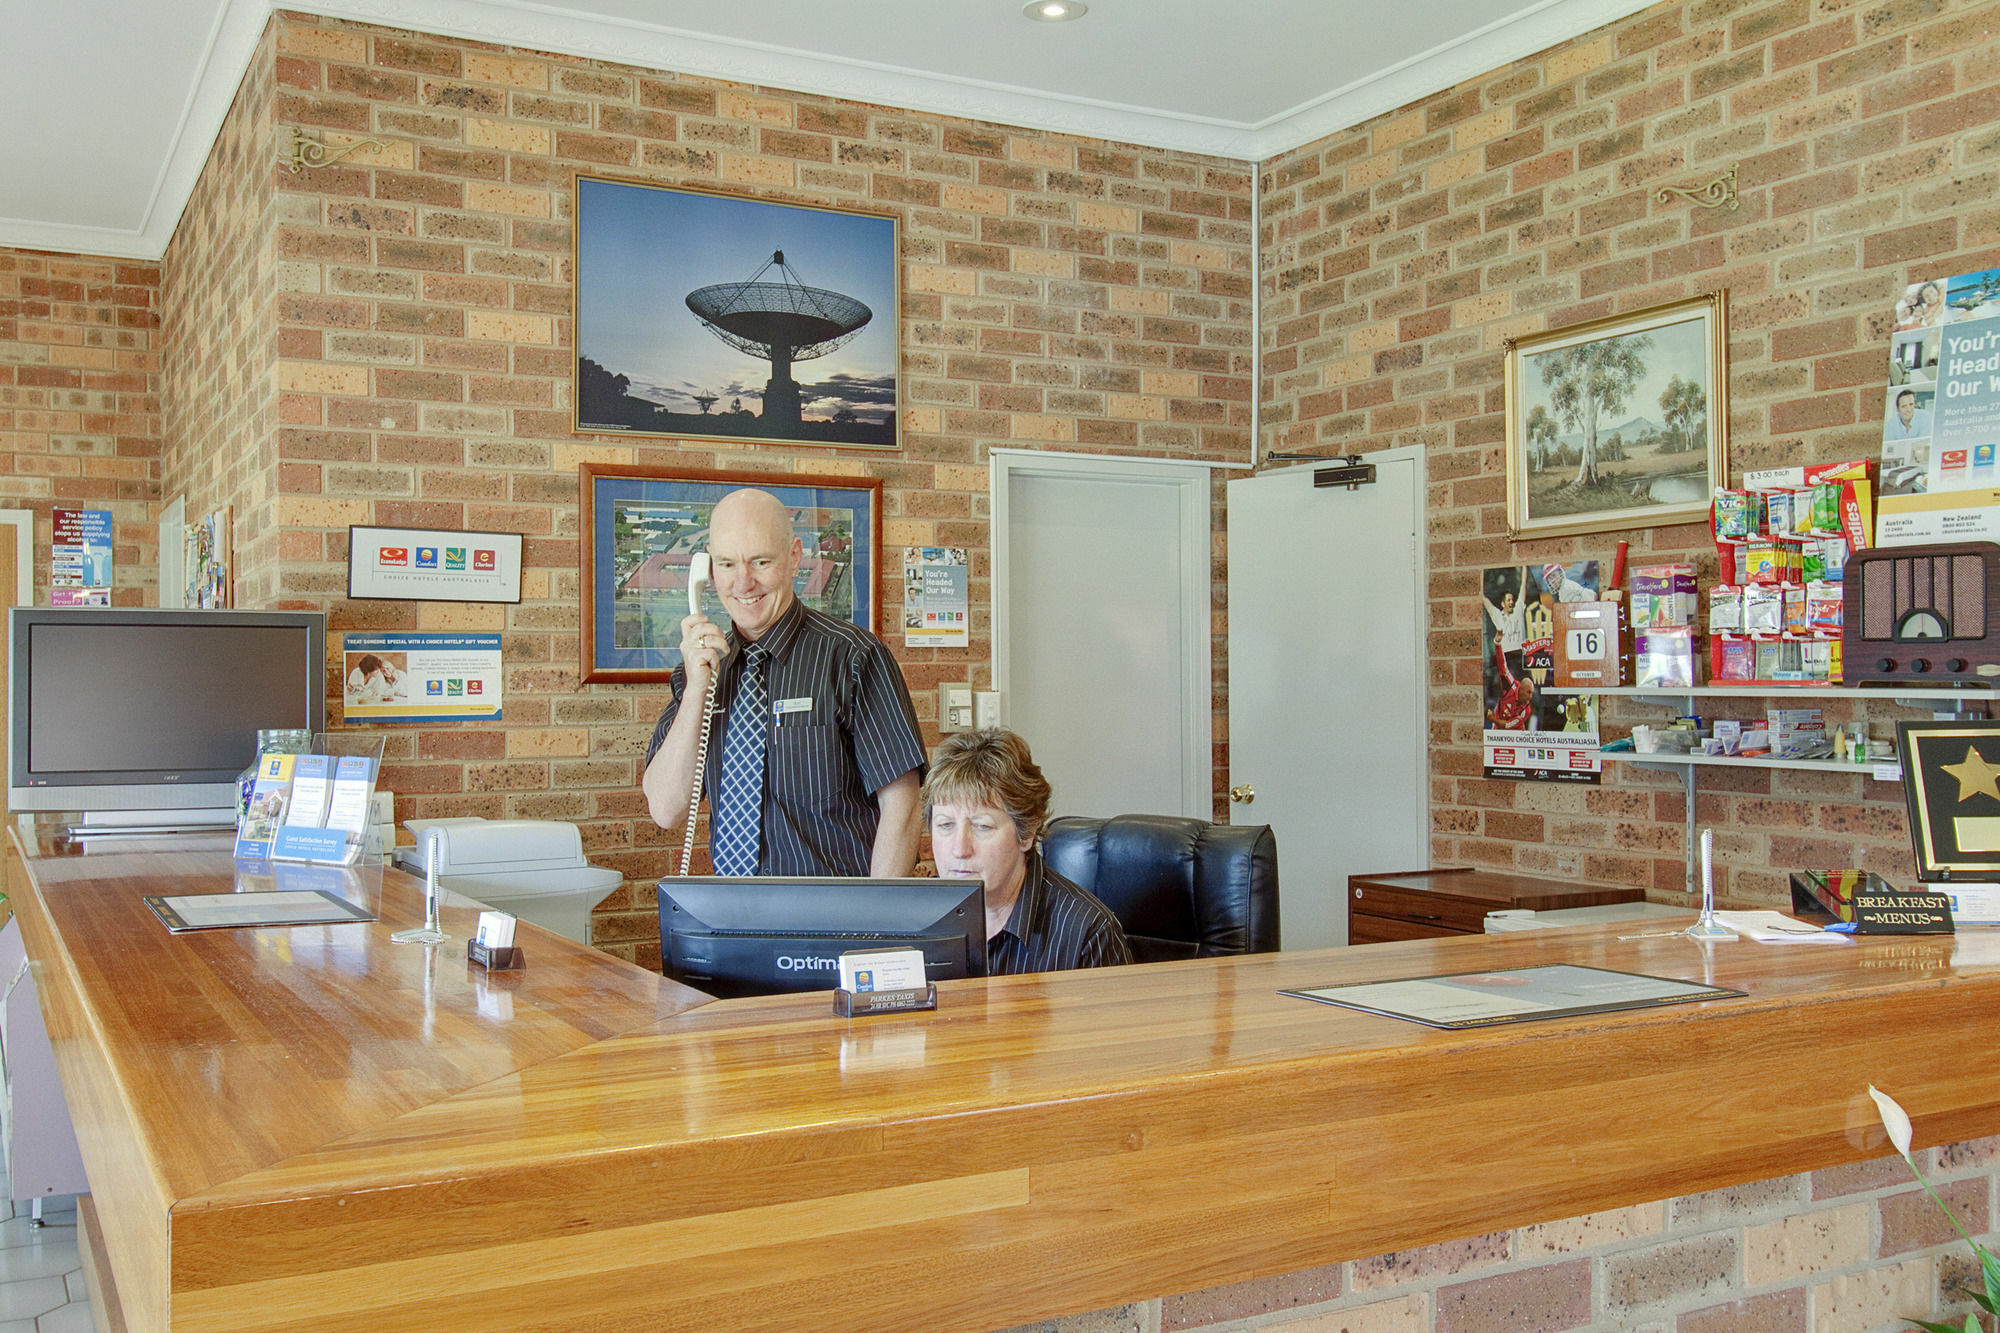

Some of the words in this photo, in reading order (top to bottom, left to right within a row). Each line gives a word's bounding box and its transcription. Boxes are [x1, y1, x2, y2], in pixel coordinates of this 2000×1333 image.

[1949, 352, 2000, 376] Head
[1946, 380, 1983, 398] Our
[1944, 408, 1966, 416] More
[1774, 470, 1790, 478] each
[925, 570, 948, 578] You're
[940, 587, 955, 596] Way
[1576, 632, 1598, 654] 16
[1536, 657, 1551, 667] ACA
[1856, 896, 1946, 908] BREAKFAST
[1875, 912, 1932, 925] MENUS
